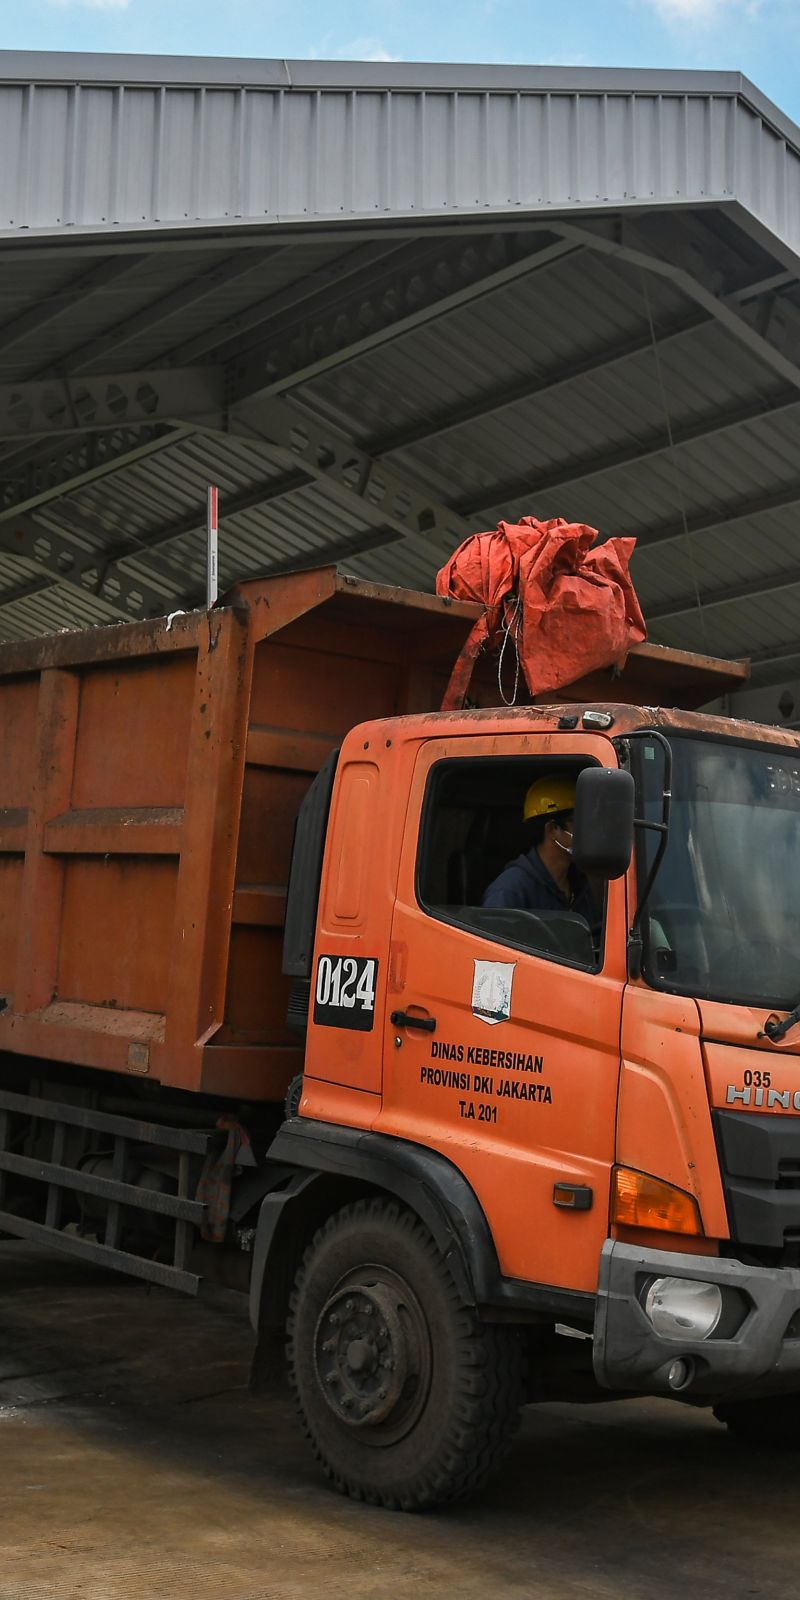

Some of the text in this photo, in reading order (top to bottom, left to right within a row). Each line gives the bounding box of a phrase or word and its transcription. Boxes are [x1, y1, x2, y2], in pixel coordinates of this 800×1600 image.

[316, 957, 375, 1011] 0124
[431, 1041, 544, 1074] DINAS KEBERSIHAN
[420, 1067, 553, 1104] PROVINSI DKI JAKARTA
[744, 1070, 771, 1088] 035
[459, 1101, 498, 1124] T.A 201
